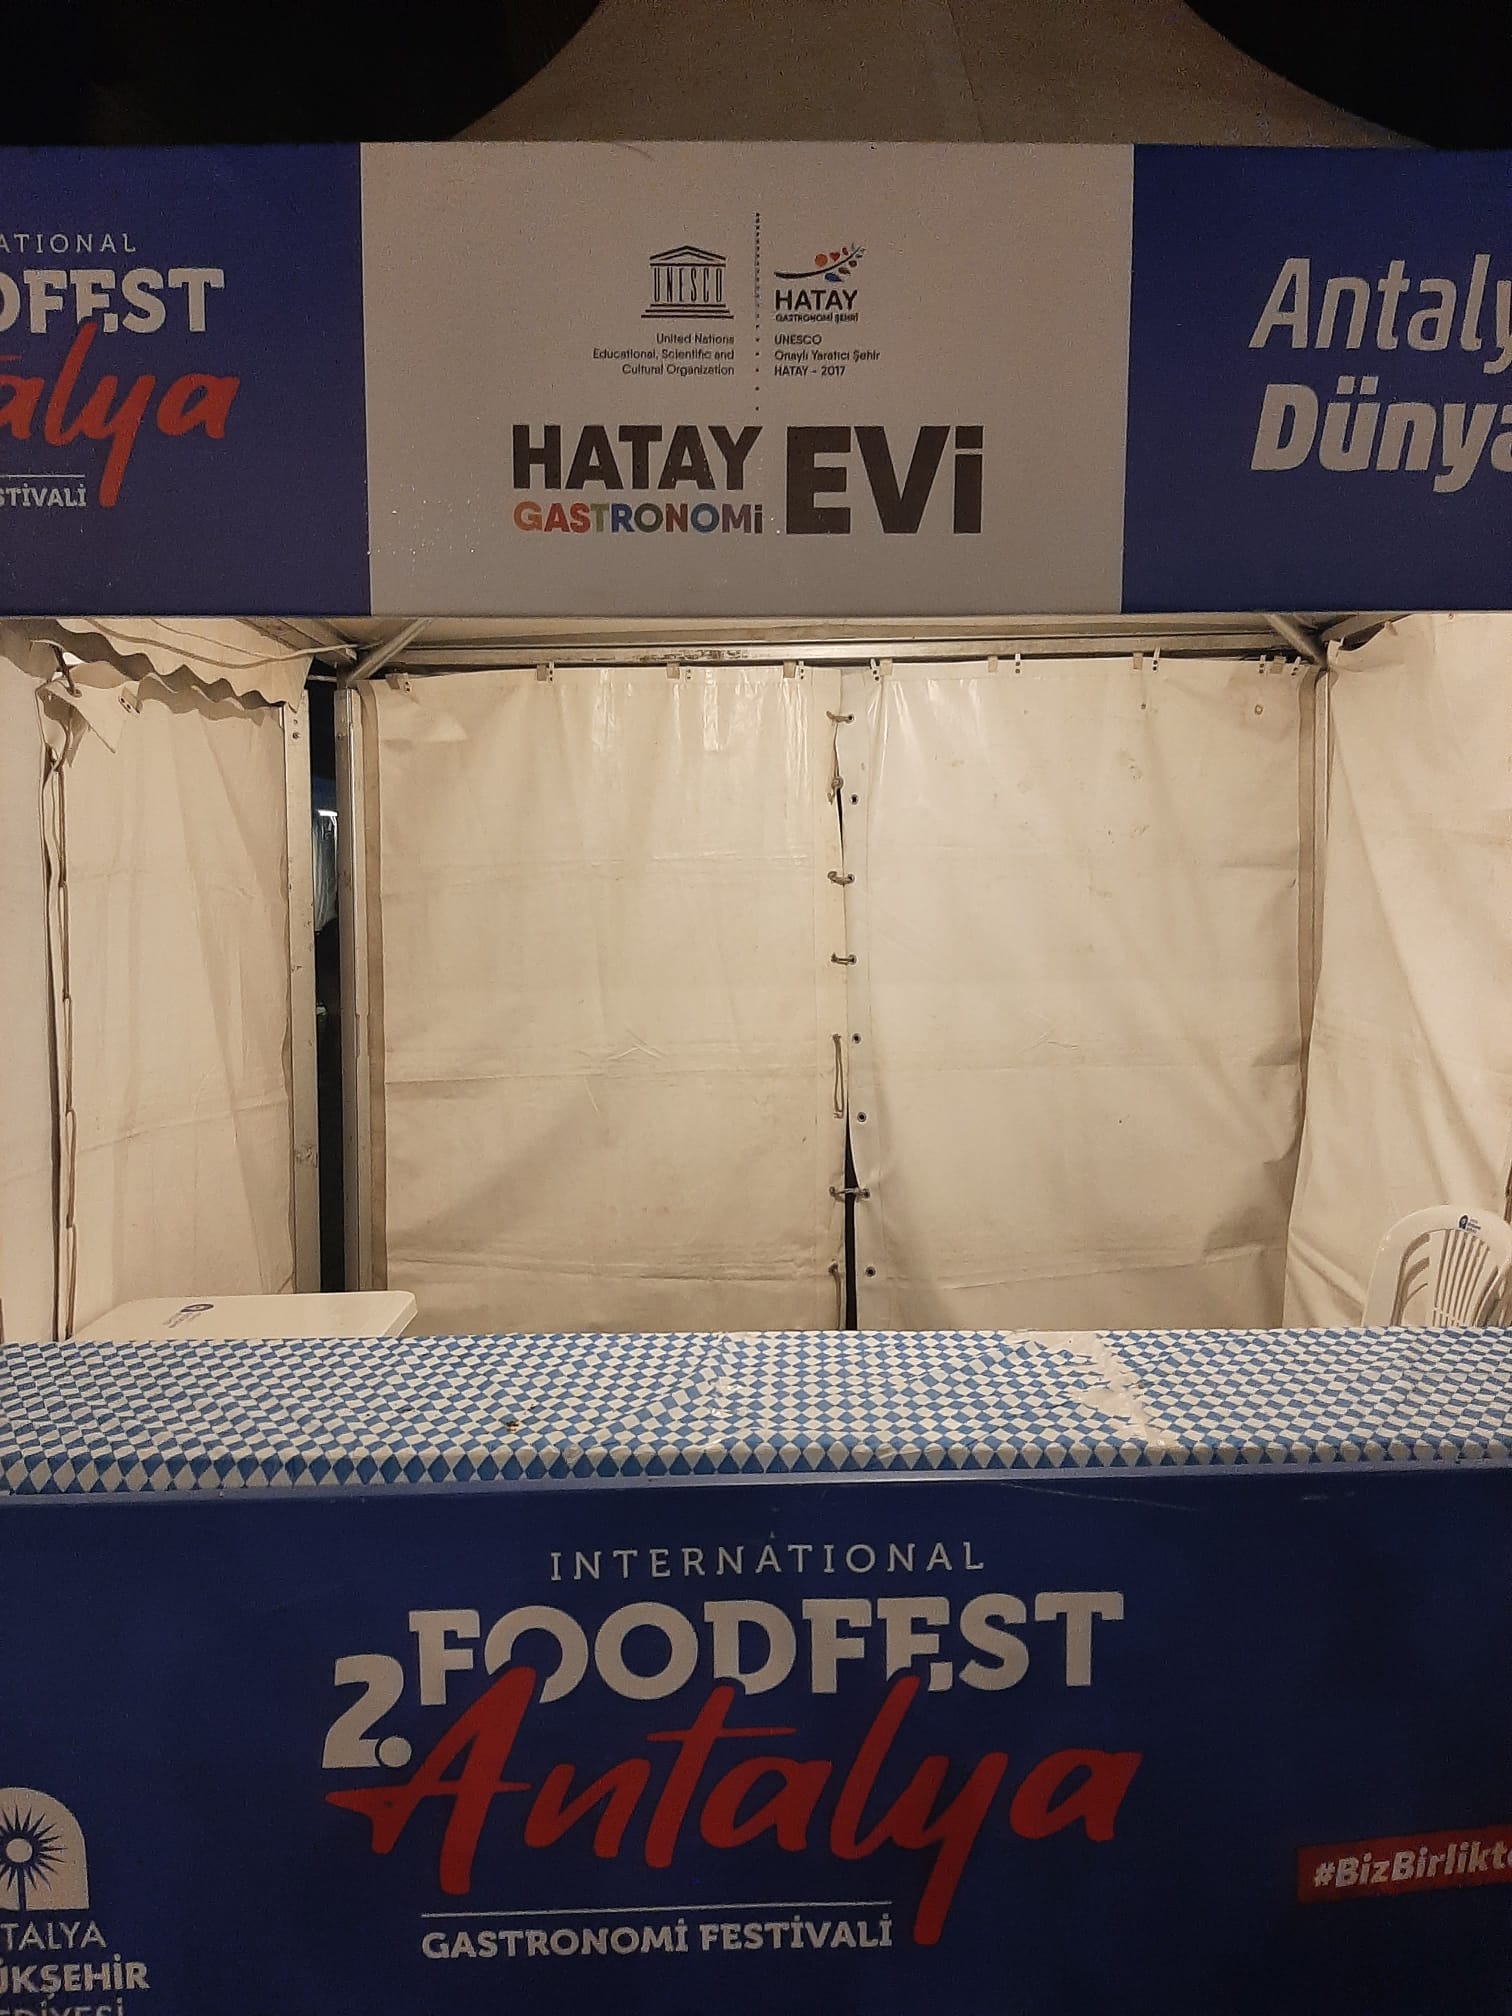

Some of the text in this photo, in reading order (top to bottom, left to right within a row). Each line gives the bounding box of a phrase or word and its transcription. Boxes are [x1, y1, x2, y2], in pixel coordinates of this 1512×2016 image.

[653, 267, 722, 303] UNESCO
[774, 289, 858, 311] HATAY
[593, 348, 735, 360] Educational, Scientific and
[656, 333, 735, 345] United Nations
[774, 334, 822, 345] UNESCO
[622, 363, 735, 377] Cultural Organization
[774, 365, 809, 376] HATAY
[821, 365, 846, 376] 2017
[0, 321, 240, 508] alya
[512, 424, 763, 490] HATAY
[550, 1541, 985, 1581] INTERNATIONAL
[321, 1591, 1124, 1769] 2. FOODFEST
[325, 1666, 1142, 1946] Antalya
[1313, 1841, 1512, 1888] #BizBirlikt
[421, 1914, 893, 1960] GASTRONOMİ FESTİVALİ
